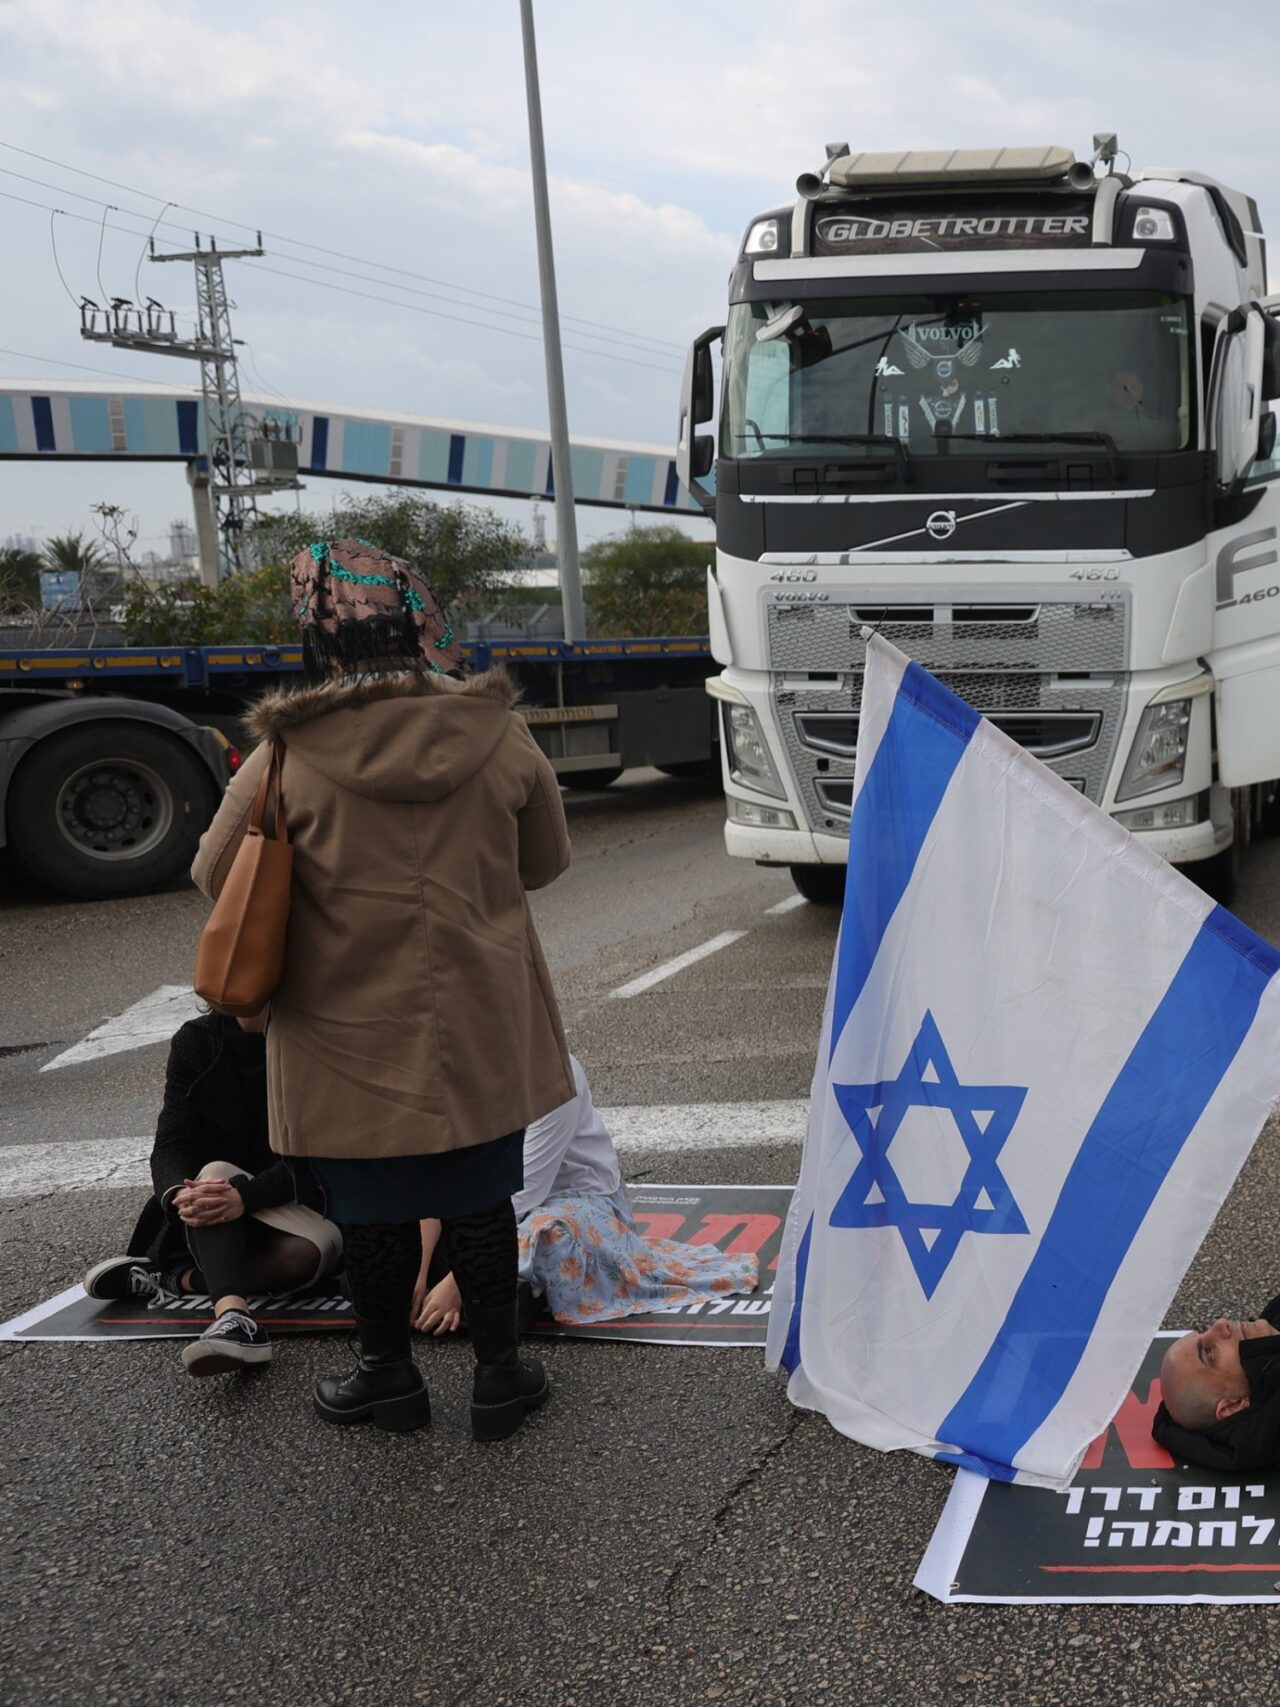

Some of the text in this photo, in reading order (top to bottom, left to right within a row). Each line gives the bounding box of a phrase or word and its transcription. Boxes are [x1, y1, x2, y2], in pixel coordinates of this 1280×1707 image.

[827, 215, 1090, 241] GLOBETROTTER
[917, 326, 973, 341] VOLVO
[770, 569, 819, 583] 460
[1068, 566, 1121, 581] 460
[773, 591, 830, 601] VOLVO
[1237, 585, 1280, 605] 460
[1177, 1484, 1266, 1511] יום
